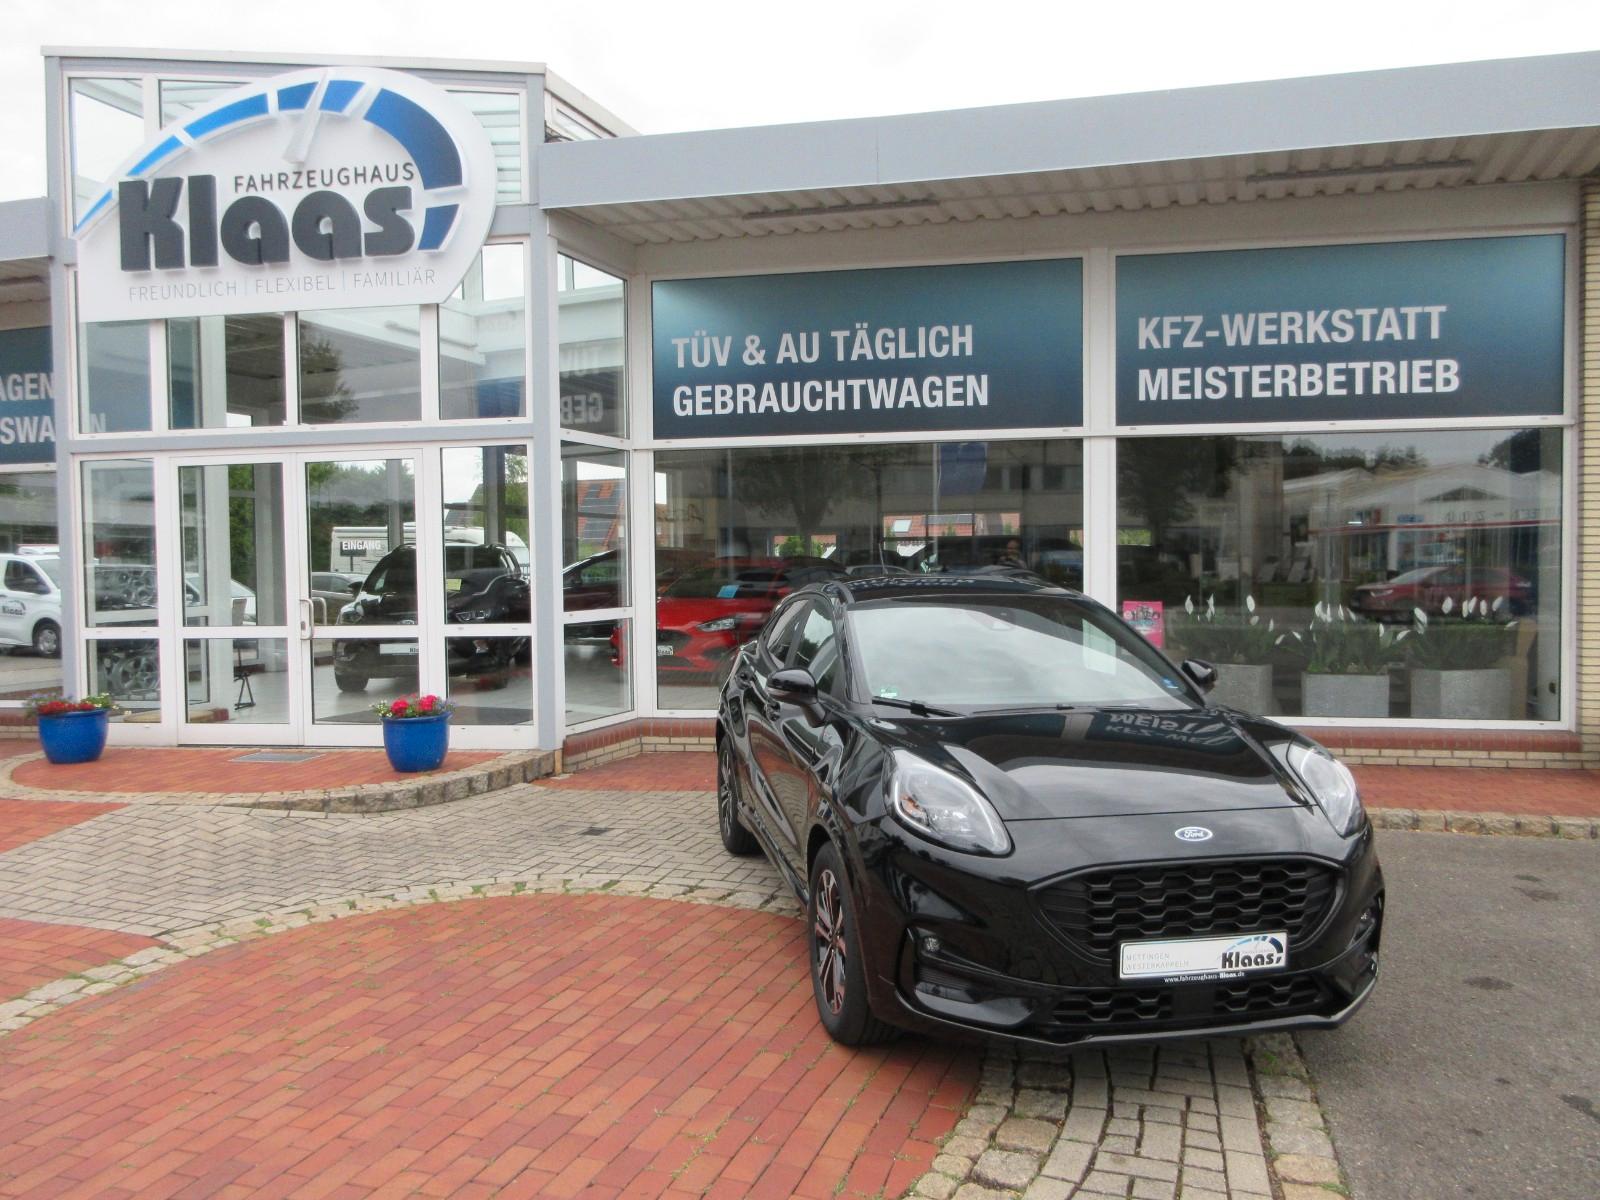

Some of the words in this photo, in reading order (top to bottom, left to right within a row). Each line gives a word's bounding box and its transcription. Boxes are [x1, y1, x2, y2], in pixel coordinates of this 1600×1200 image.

[234, 162, 415, 193] FAHRZEUGHAUS
[118, 174, 415, 272] Klaas
[128, 279, 238, 303] FREUNDLICH
[254, 274, 336, 295] FLEXIBEL
[353, 266, 436, 289] FAMILIÄR
[671, 330, 733, 369] TÜV
[741, 334, 767, 367] &
[776, 330, 820, 365] AU
[830, 321, 974, 362] TÄGLICH
[1137, 304, 1448, 350] KFZ-WERKSTATT
[672, 373, 989, 417] GEBRAUCHTWAGEN
[1137, 358, 1461, 402] MEISTERBETRIEB
[341, 540, 381, 551] EINGANG
[1221, 952, 1275, 968] Klaas
